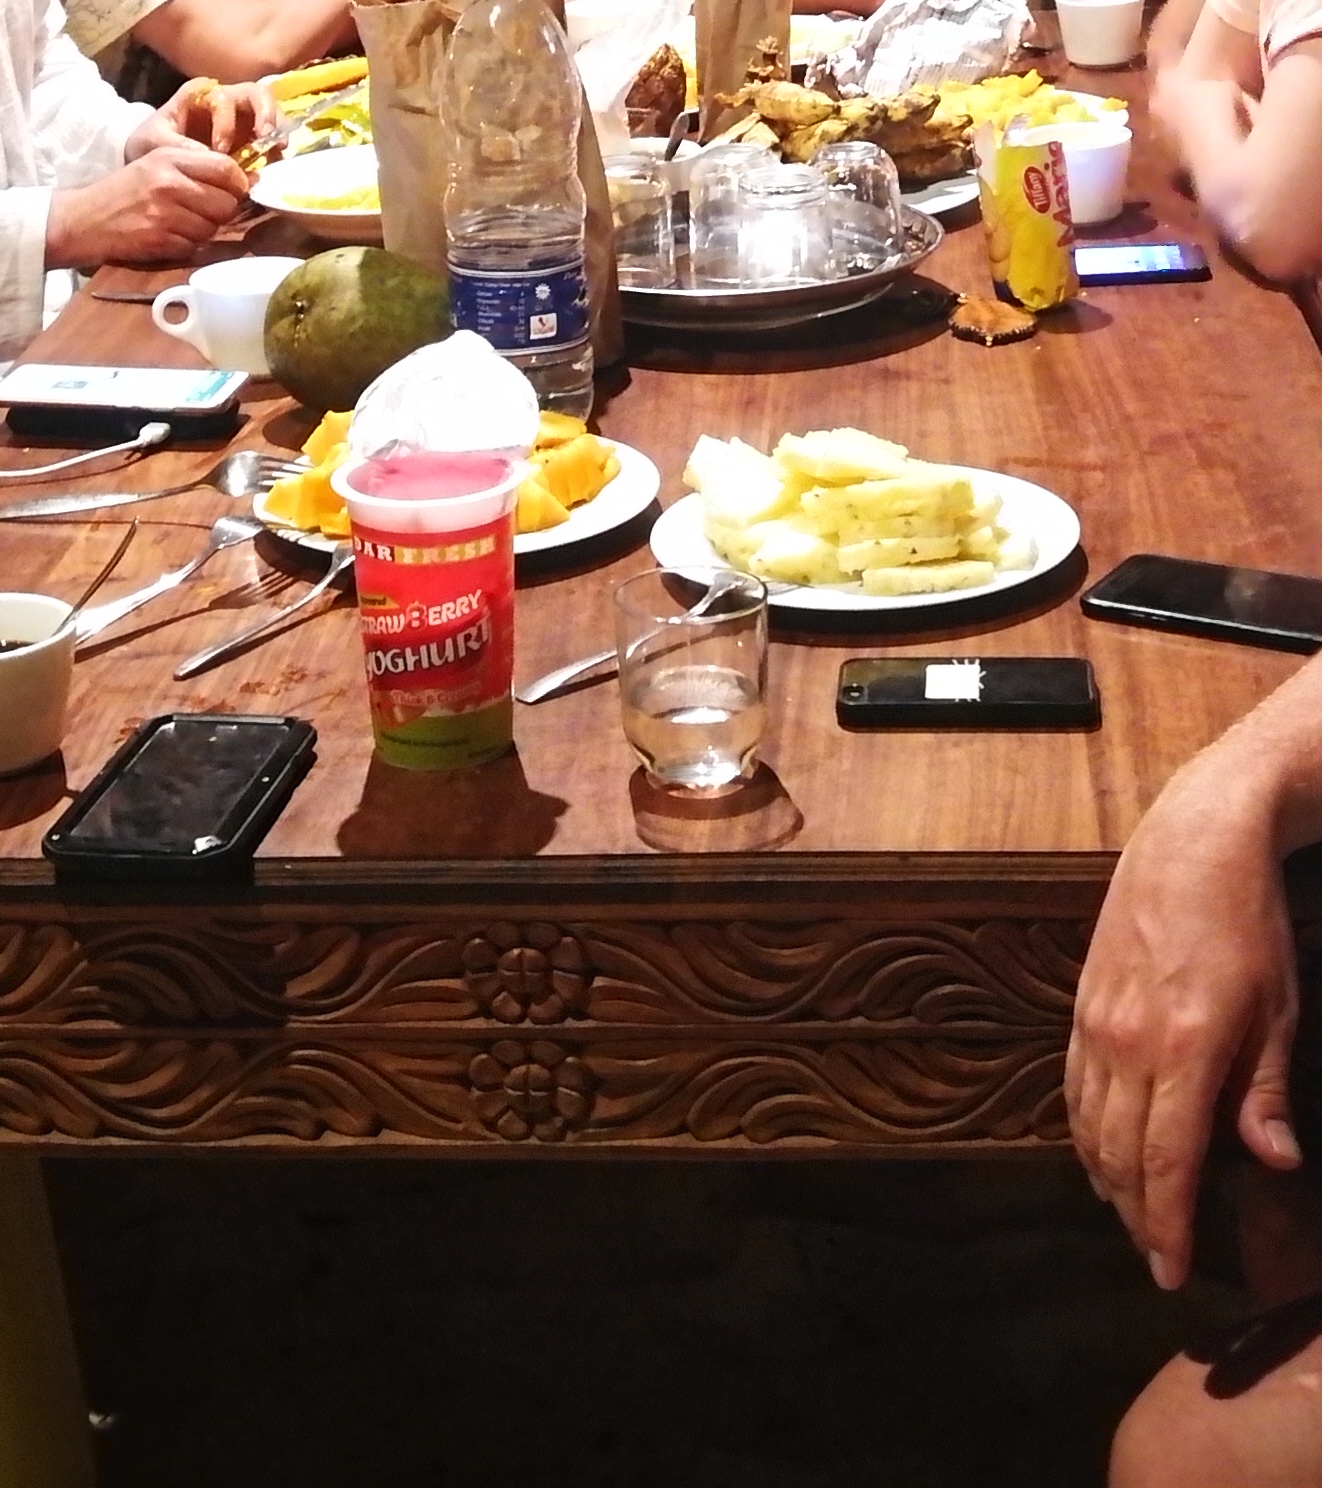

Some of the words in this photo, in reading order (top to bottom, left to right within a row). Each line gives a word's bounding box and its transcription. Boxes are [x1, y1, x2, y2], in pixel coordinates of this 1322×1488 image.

[1028, 172, 1048, 208] Tiffany
[354, 535, 393, 563] DAR
[402, 535, 496, 566] FRESH
